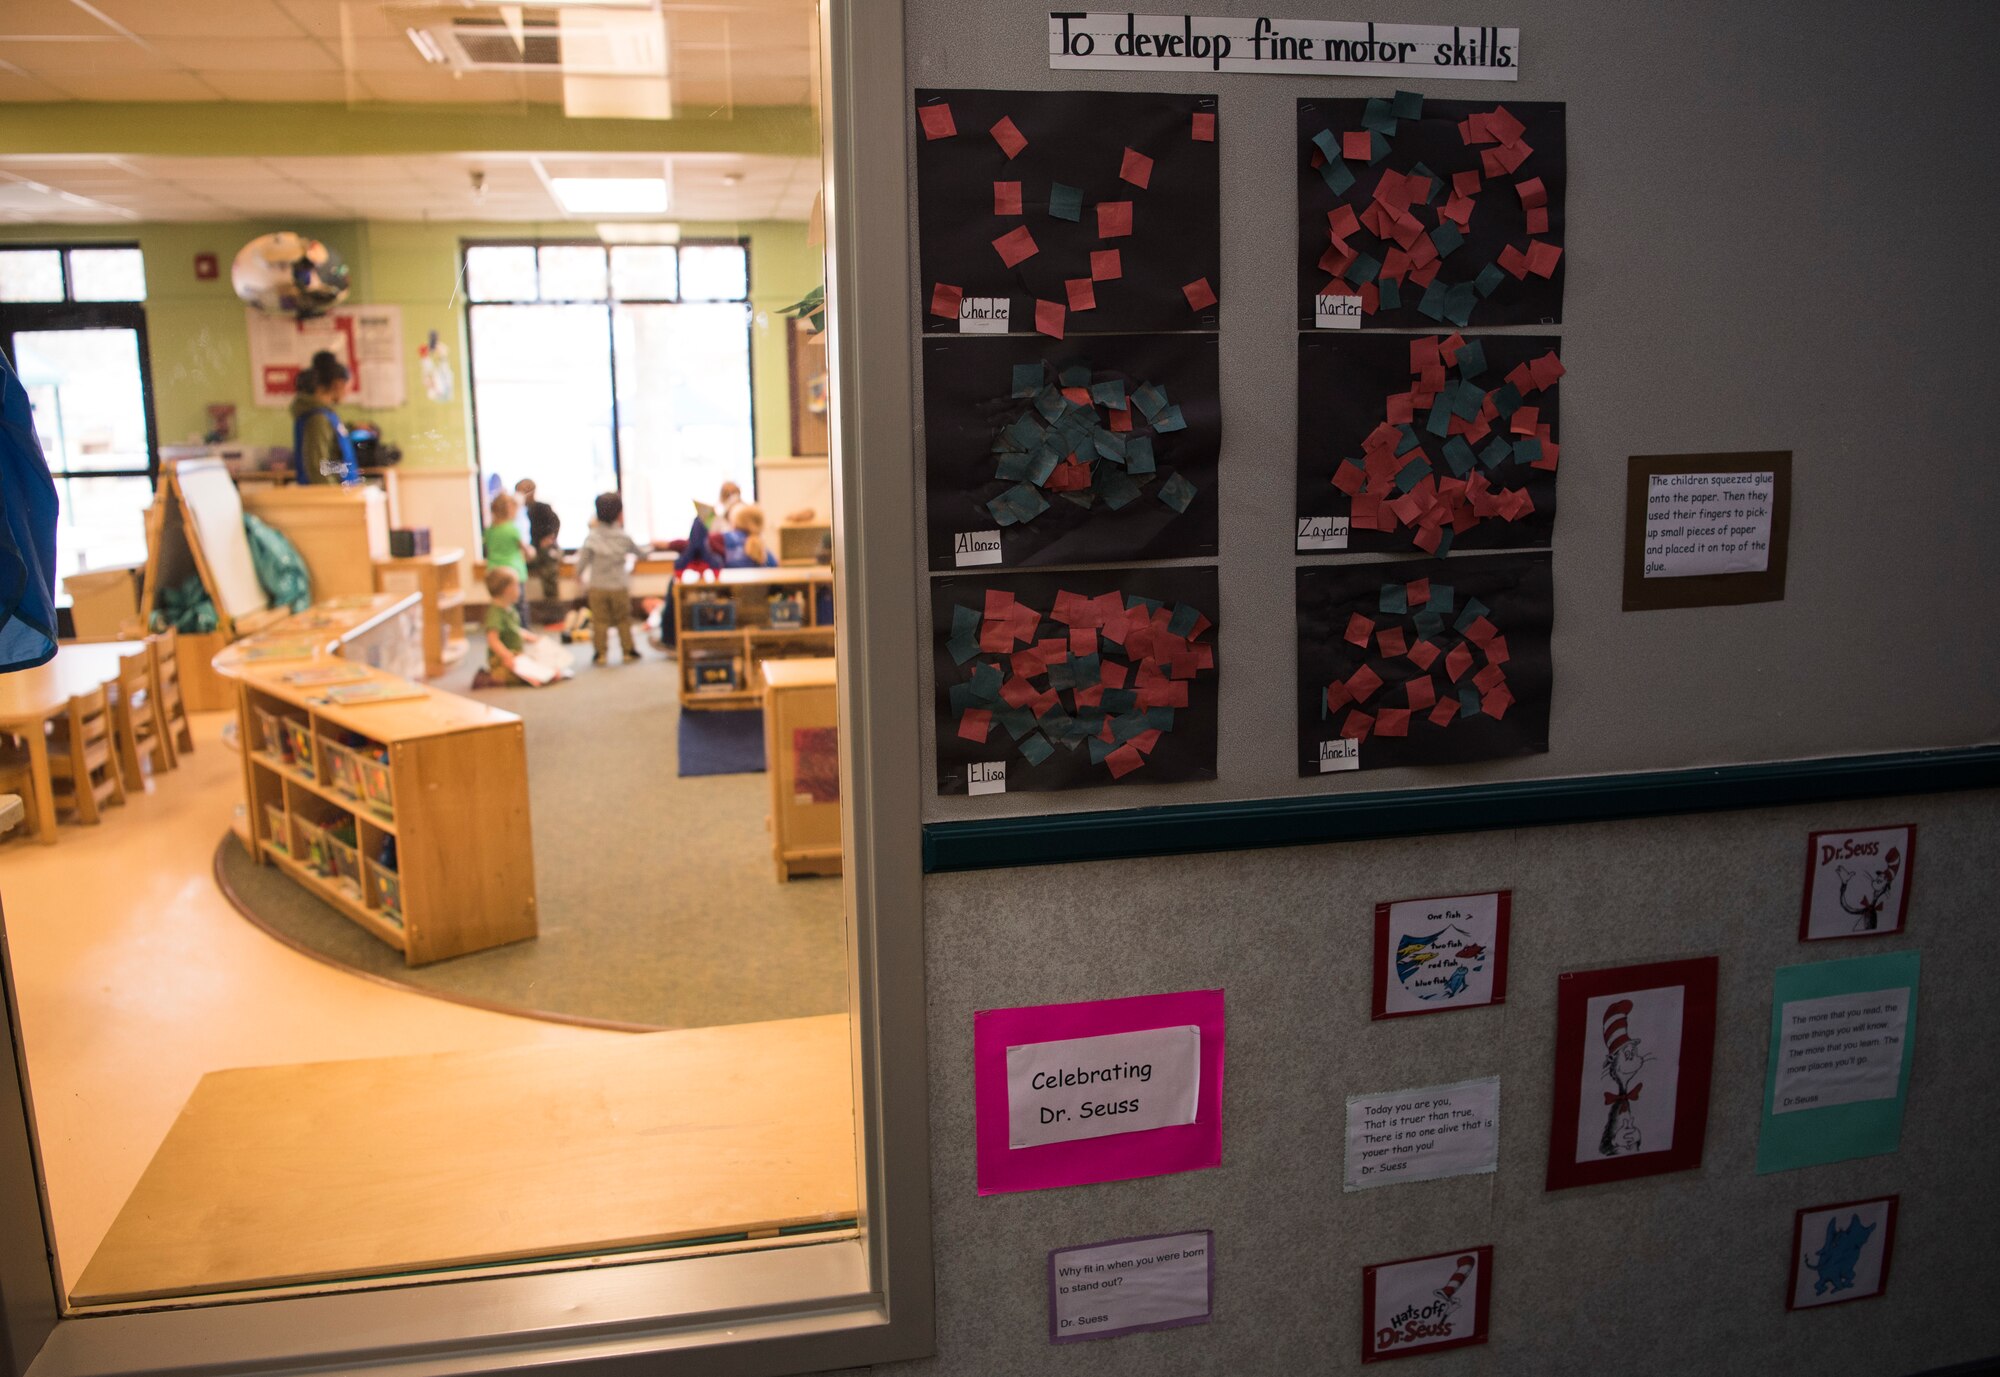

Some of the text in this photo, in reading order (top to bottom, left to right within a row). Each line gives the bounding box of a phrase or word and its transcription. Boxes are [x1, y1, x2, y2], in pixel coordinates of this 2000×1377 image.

[1050, 12, 1517, 71] To develop fine motor skills.
[961, 298, 1007, 319] Charlee
[1320, 295, 1362, 315] Karter
[1652, 474, 1773, 486] The children squeezed glue
[1650, 491, 1767, 504] onto the paper. Then they
[1649, 508, 1767, 520] used their fingers to pick-
[1299, 517, 1348, 541] Zayden
[1648, 525, 1756, 539] up small pieces of paper
[957, 533, 999, 553] Alonzo
[1647, 545, 1662, 554] and
[1666, 544, 1695, 555] placed
[1698, 544, 1705, 552] it
[1721, 544, 1735, 553] top
[1739, 541, 1748, 550] of
[1751, 541, 1765, 550] the
[1646, 562, 1666, 574] glue.
[1320, 740, 1356, 760] Annelie
[971, 762, 1004, 782] Elisa
[1446, 911, 1461, 919] fish
[1448, 940, 1462, 948] fish
[1444, 959, 1458, 967] fish
[1415, 977, 1448, 987] blue fish
[1792, 1016, 1806, 1025] The
[1831, 1010, 1845, 1018] that
[1847, 1009, 1861, 1017] you
[1791, 1033, 1810, 1041] more
[1812, 1029, 1834, 1038] things
[1836, 1027, 1850, 1036] you
[1853, 1023, 1865, 1031] will
[1789, 1049, 1803, 1057] The
[1805, 1047, 1824, 1055] more
[1827, 1043, 1841, 1052] that
[1843, 1042, 1857, 1050] you
[1884, 1037, 1899, 1045] The
[1032, 1062, 1151, 1089] Celebrating
[1787, 1066, 1806, 1074] more
[1808, 1061, 1833, 1072] places
[1041, 1099, 1139, 1124] Dr. Seuss
[1365, 1098, 1451, 1115] Today you are you,
[1365, 1120, 1386, 1129] That
[1390, 1118, 1396, 1126] is
[1401, 1116, 1425, 1125] truer
[1429, 1112, 1449, 1121] than
[1364, 1134, 1392, 1143] There
[1395, 1132, 1402, 1140] is
[1438, 1124, 1458, 1134] alive
[1462, 1121, 1481, 1130] that
[1485, 1119, 1492, 1127] is
[1362, 1141, 1434, 1160] youer than you!
[1362, 1162, 1407, 1174] Dr. Suess
[1059, 1268, 1081, 1277] Why
[1084, 1265, 1093, 1273] fit
[1107, 1259, 1133, 1269] when
[1136, 1257, 1154, 1267] you
[1157, 1253, 1180, 1262] were
[1183, 1249, 1204, 1258] born
[1072, 1282, 1099, 1292] stand
[1102, 1277, 1123, 1288] out?
[1061, 1314, 1108, 1328] Dr. Suess
[1391, 1304, 1419, 1329] Hats
